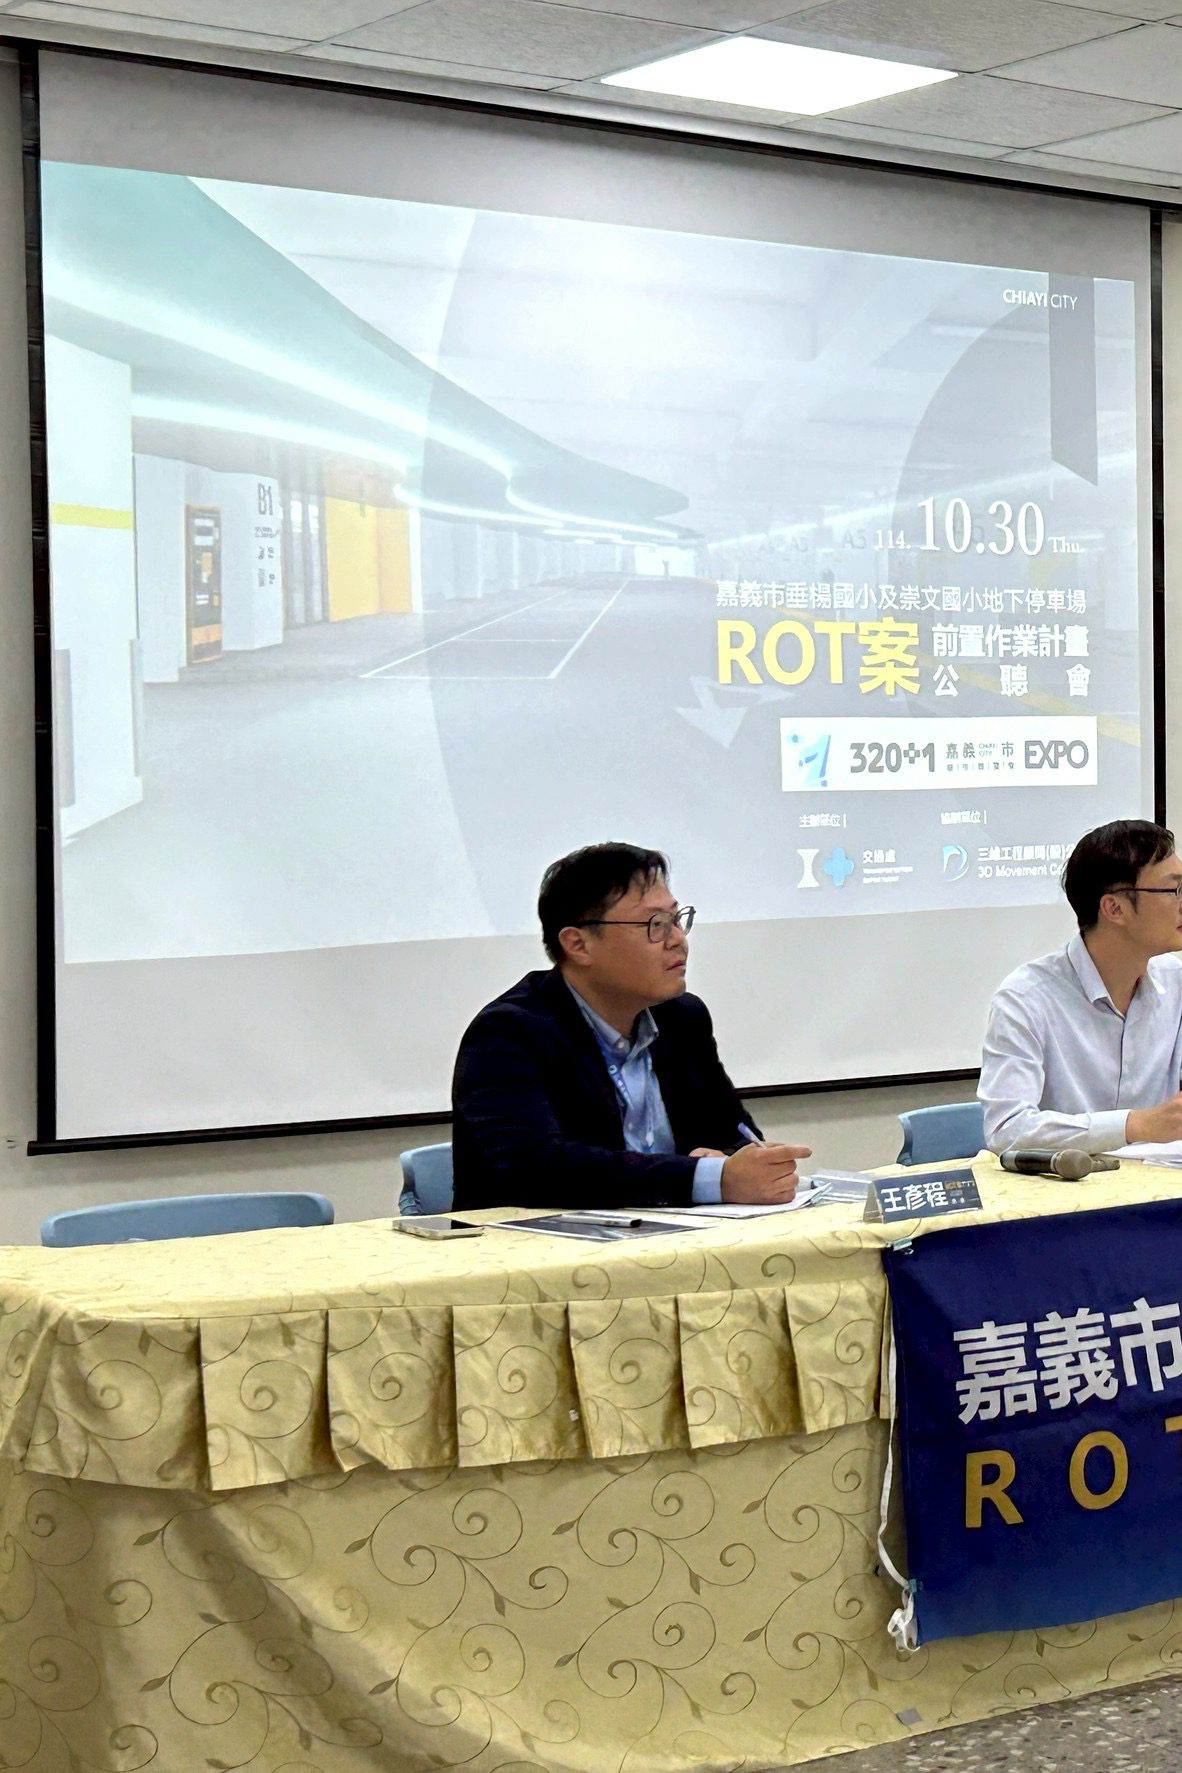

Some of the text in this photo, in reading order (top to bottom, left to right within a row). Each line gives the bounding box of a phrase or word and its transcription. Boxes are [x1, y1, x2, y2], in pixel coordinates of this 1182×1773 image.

[1003, 289, 1078, 310] CHIAYI CITY
[917, 496, 1045, 555] 10.30
[715, 579, 1088, 615] 嘉義市垂楊國小及崇文國小地下停車場
[716, 616, 920, 696] ROT案
[931, 623, 1090, 658] 前置作業計畫
[1024, 739, 1090, 770] EXPO
[995, 864, 1048, 877] Movement
